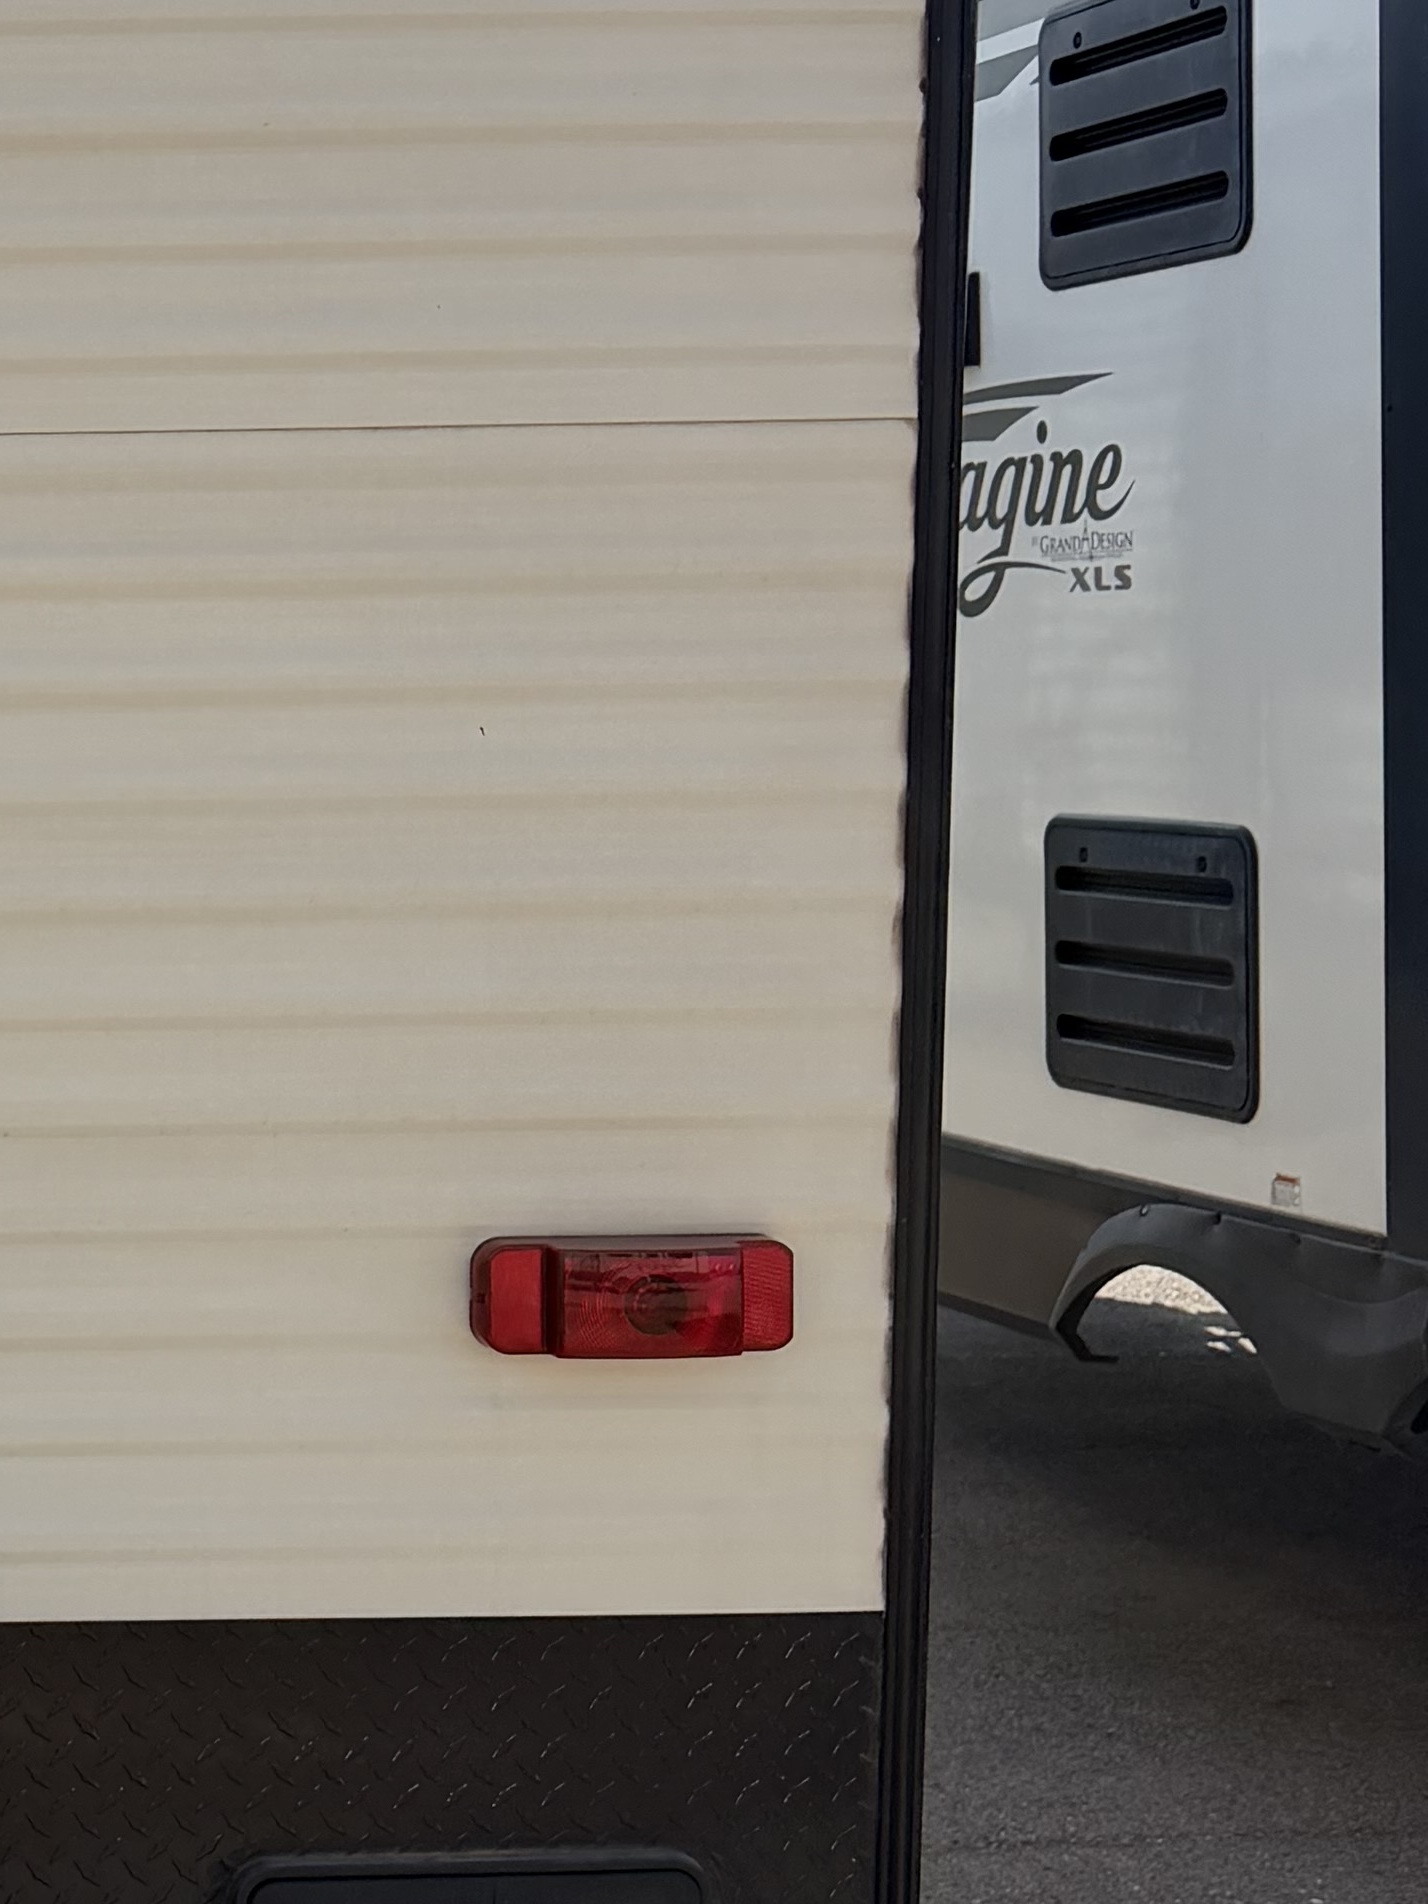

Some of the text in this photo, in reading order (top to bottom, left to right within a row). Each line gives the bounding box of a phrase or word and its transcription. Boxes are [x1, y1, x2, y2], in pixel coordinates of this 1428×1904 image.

[1040, 535, 1082, 555] GRAND
[1091, 530, 1133, 550] DESIGN
[1069, 564, 1132, 593] XLS
